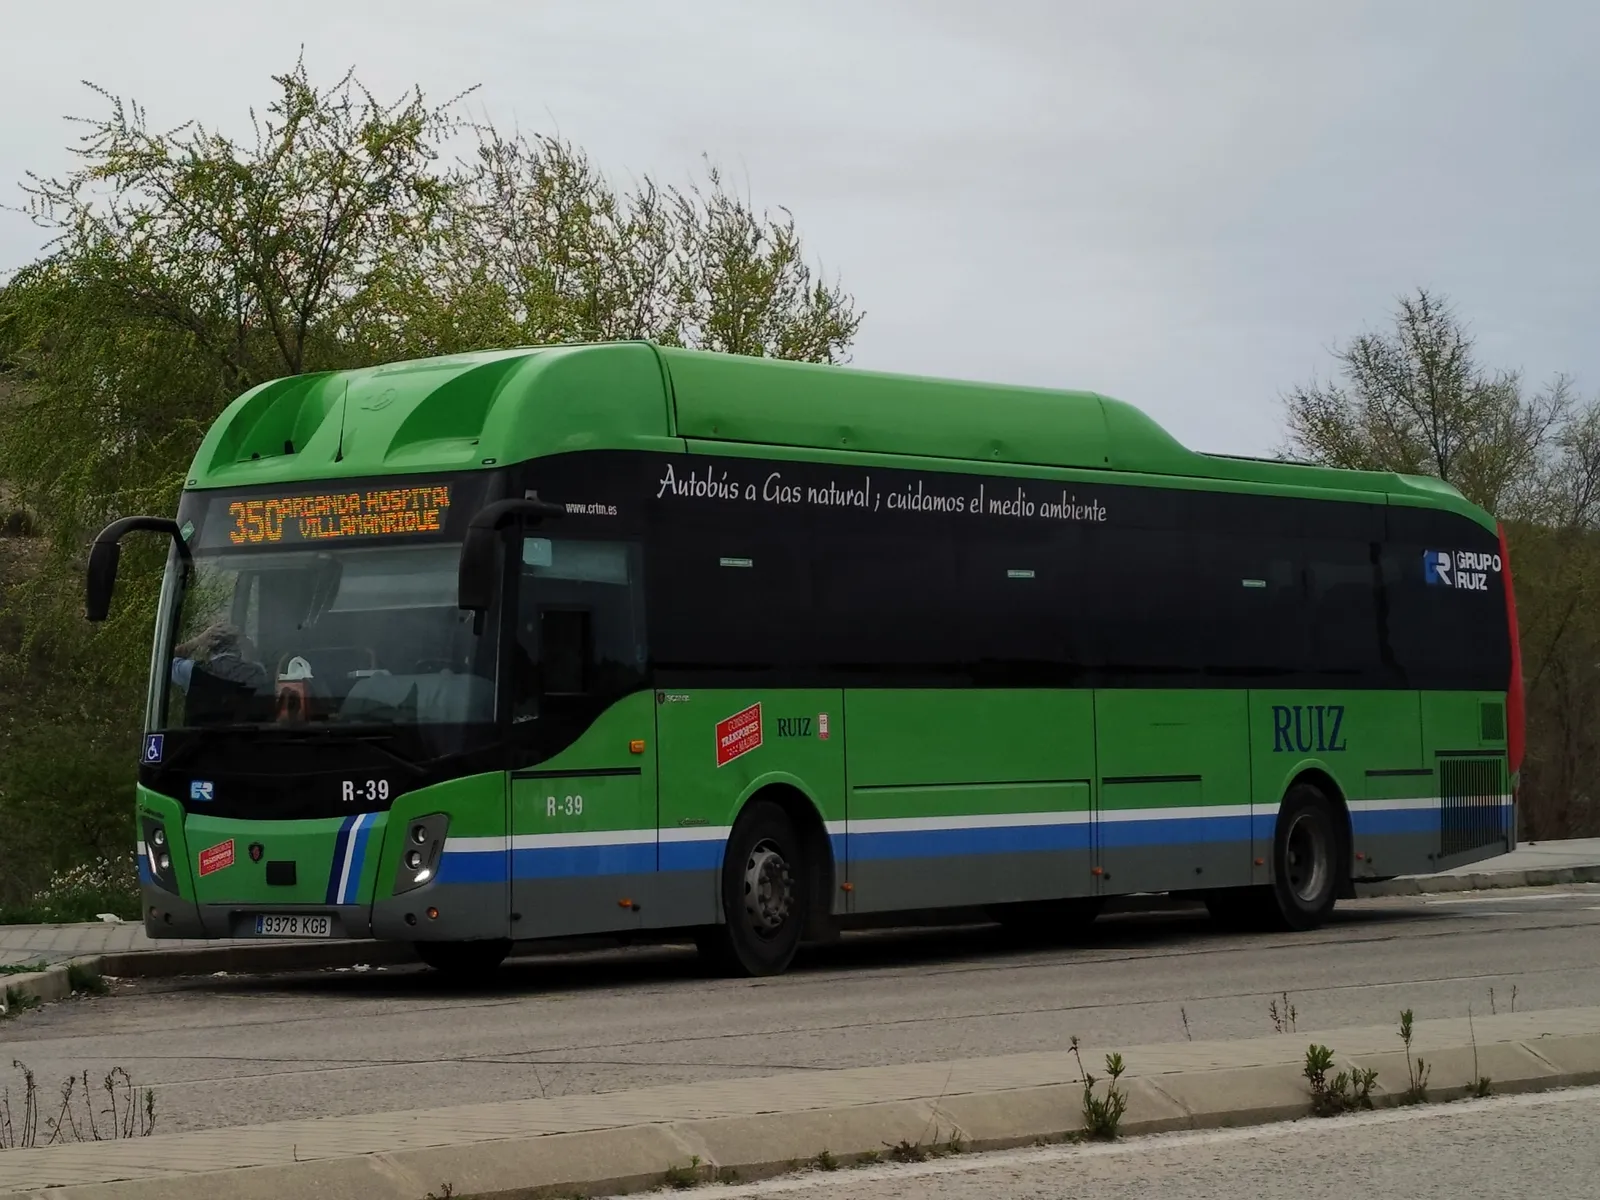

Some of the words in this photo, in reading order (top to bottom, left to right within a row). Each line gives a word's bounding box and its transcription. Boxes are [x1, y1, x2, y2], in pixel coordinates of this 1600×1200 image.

[657, 463, 739, 499] Autobús
[745, 483, 757, 501] a
[762, 472, 801, 504] Gas
[807, 476, 870, 508] natural
[887, 480, 964, 513] cuidamos
[970, 484, 984, 514] el
[989, 486, 1035, 517] medio
[1040, 490, 1107, 522] ambiente
[565, 502, 618, 516] www.crtm.es
[229, 501, 282, 544] 350
[299, 509, 440, 539] VILLAMANRIQUE
[1456, 550, 1502, 572] GRUPO
[1456, 571, 1488, 591] RUIZ
[777, 717, 812, 737] RUIZ
[1271, 705, 1347, 752] RUIZ
[342, 779, 389, 801] R-39
[546, 795, 583, 816] R-39
[265, 917, 298, 933] 9378
[302, 918, 327, 934] KGB
